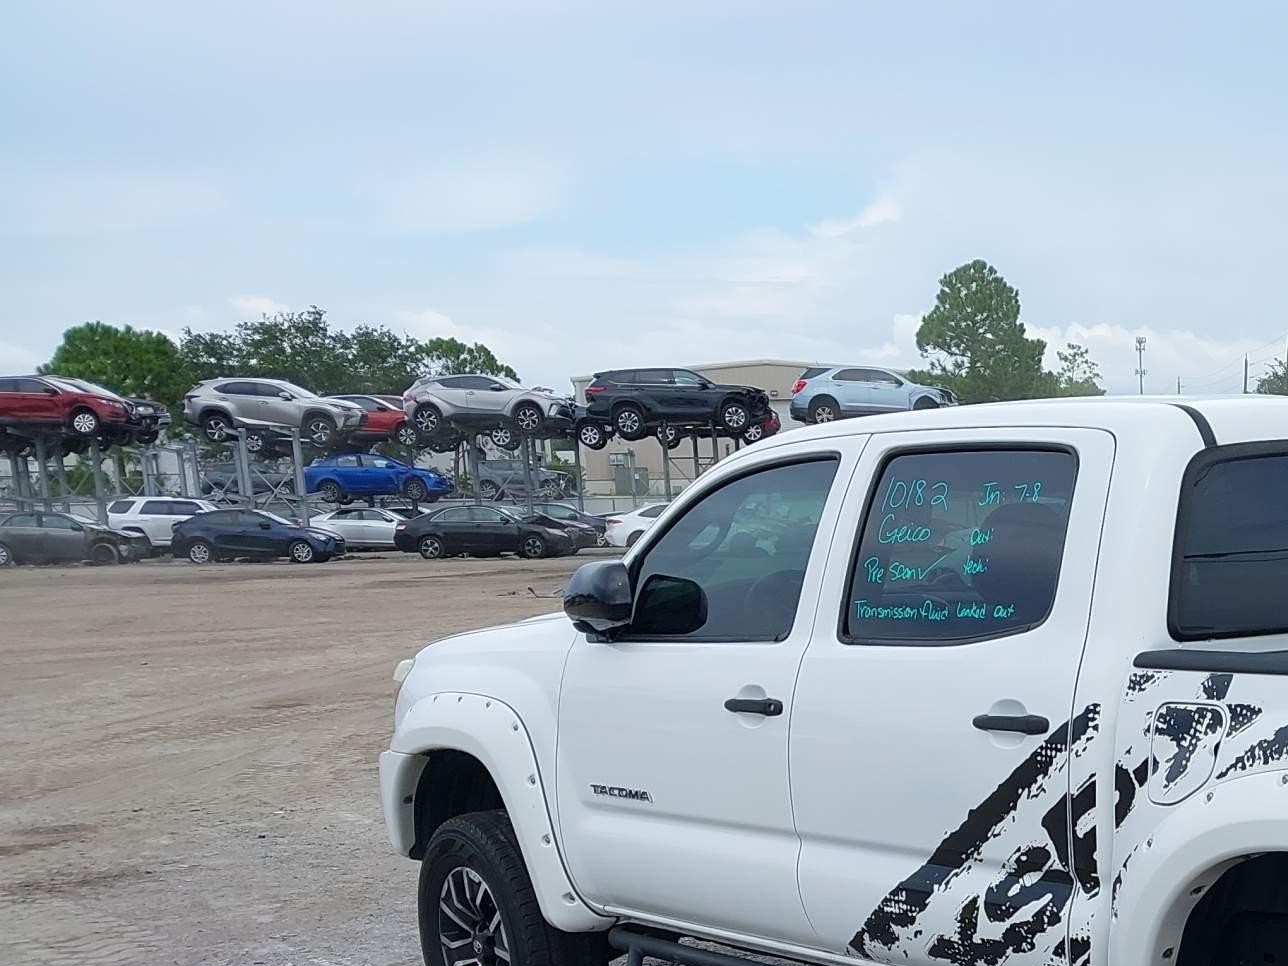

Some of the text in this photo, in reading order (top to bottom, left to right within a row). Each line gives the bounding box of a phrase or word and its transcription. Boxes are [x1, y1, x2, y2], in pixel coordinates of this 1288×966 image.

[881, 477, 948, 512] 10182
[878, 513, 931, 544] Geico
[864, 557, 884, 584] Pre
[854, 600, 917, 619] Transmission
[590, 784, 653, 803] TACOMA
